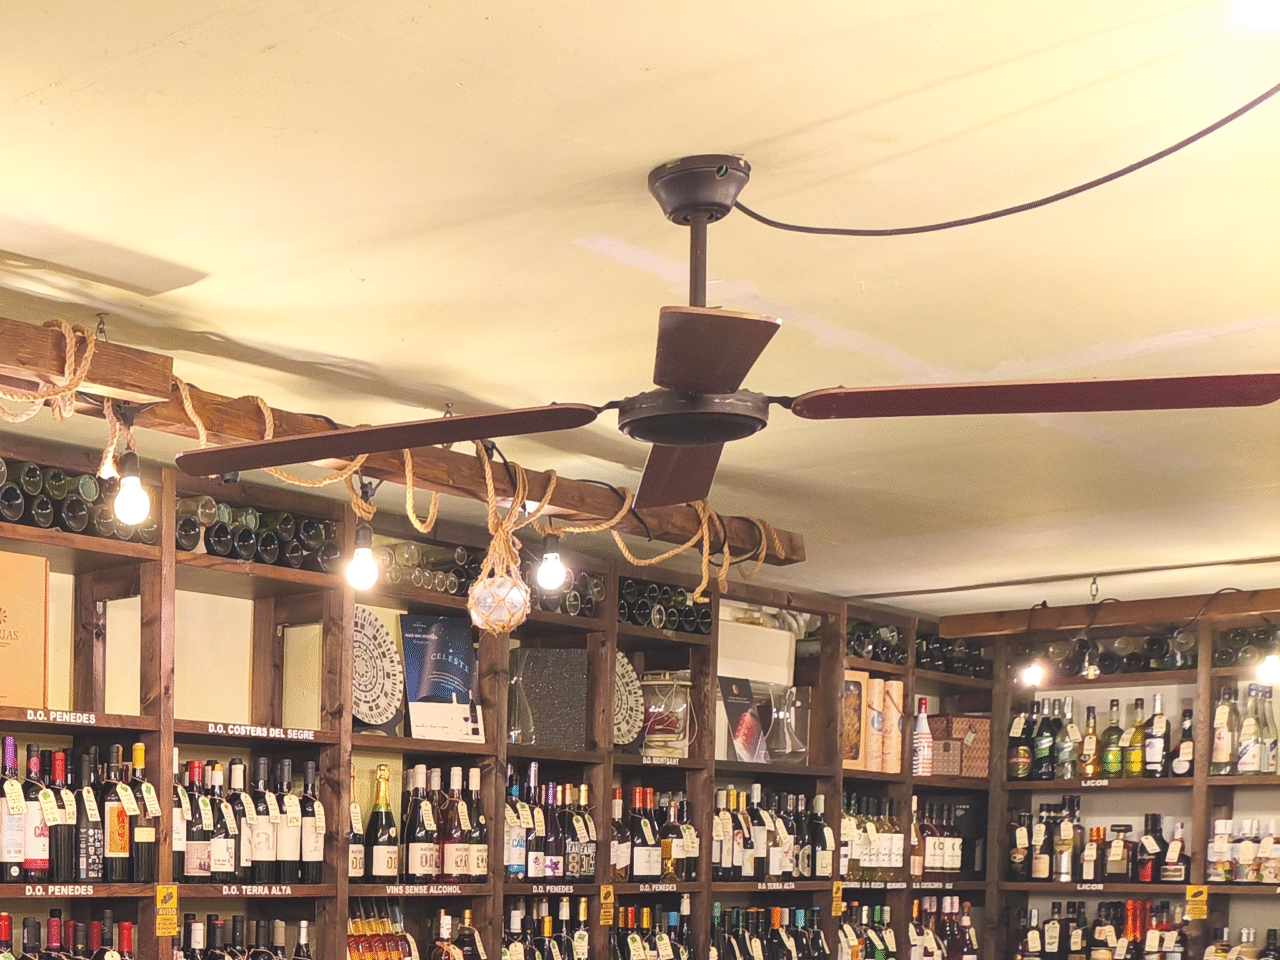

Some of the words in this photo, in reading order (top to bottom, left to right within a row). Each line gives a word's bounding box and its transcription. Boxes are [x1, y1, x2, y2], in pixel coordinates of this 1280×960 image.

[26, 709, 47, 721] D.O.
[50, 711, 96, 724] PENEDES
[208, 723, 226, 734] D.O.
[228, 725, 267, 737] COSTERS
[269, 728, 286, 738] DEL
[287, 729, 315, 740] SEGRE
[1081, 779, 1109, 787] LICOR
[25, 886, 46, 895] D.O.
[48, 886, 94, 895] PENEDES
[222, 886, 239, 895] D.O.
[242, 886, 269, 895] TERRA
[271, 886, 291, 895] ALTA
[386, 885, 403, 895] VINS
[405, 885, 428, 894] SENSE
[430, 884, 461, 893] ALCOHOL
[533, 885, 544, 893] D.O.
[546, 885, 574, 893] PENEDES
[652, 883, 677, 892] PENEDES
[1077, 883, 1104, 891] LICOR
